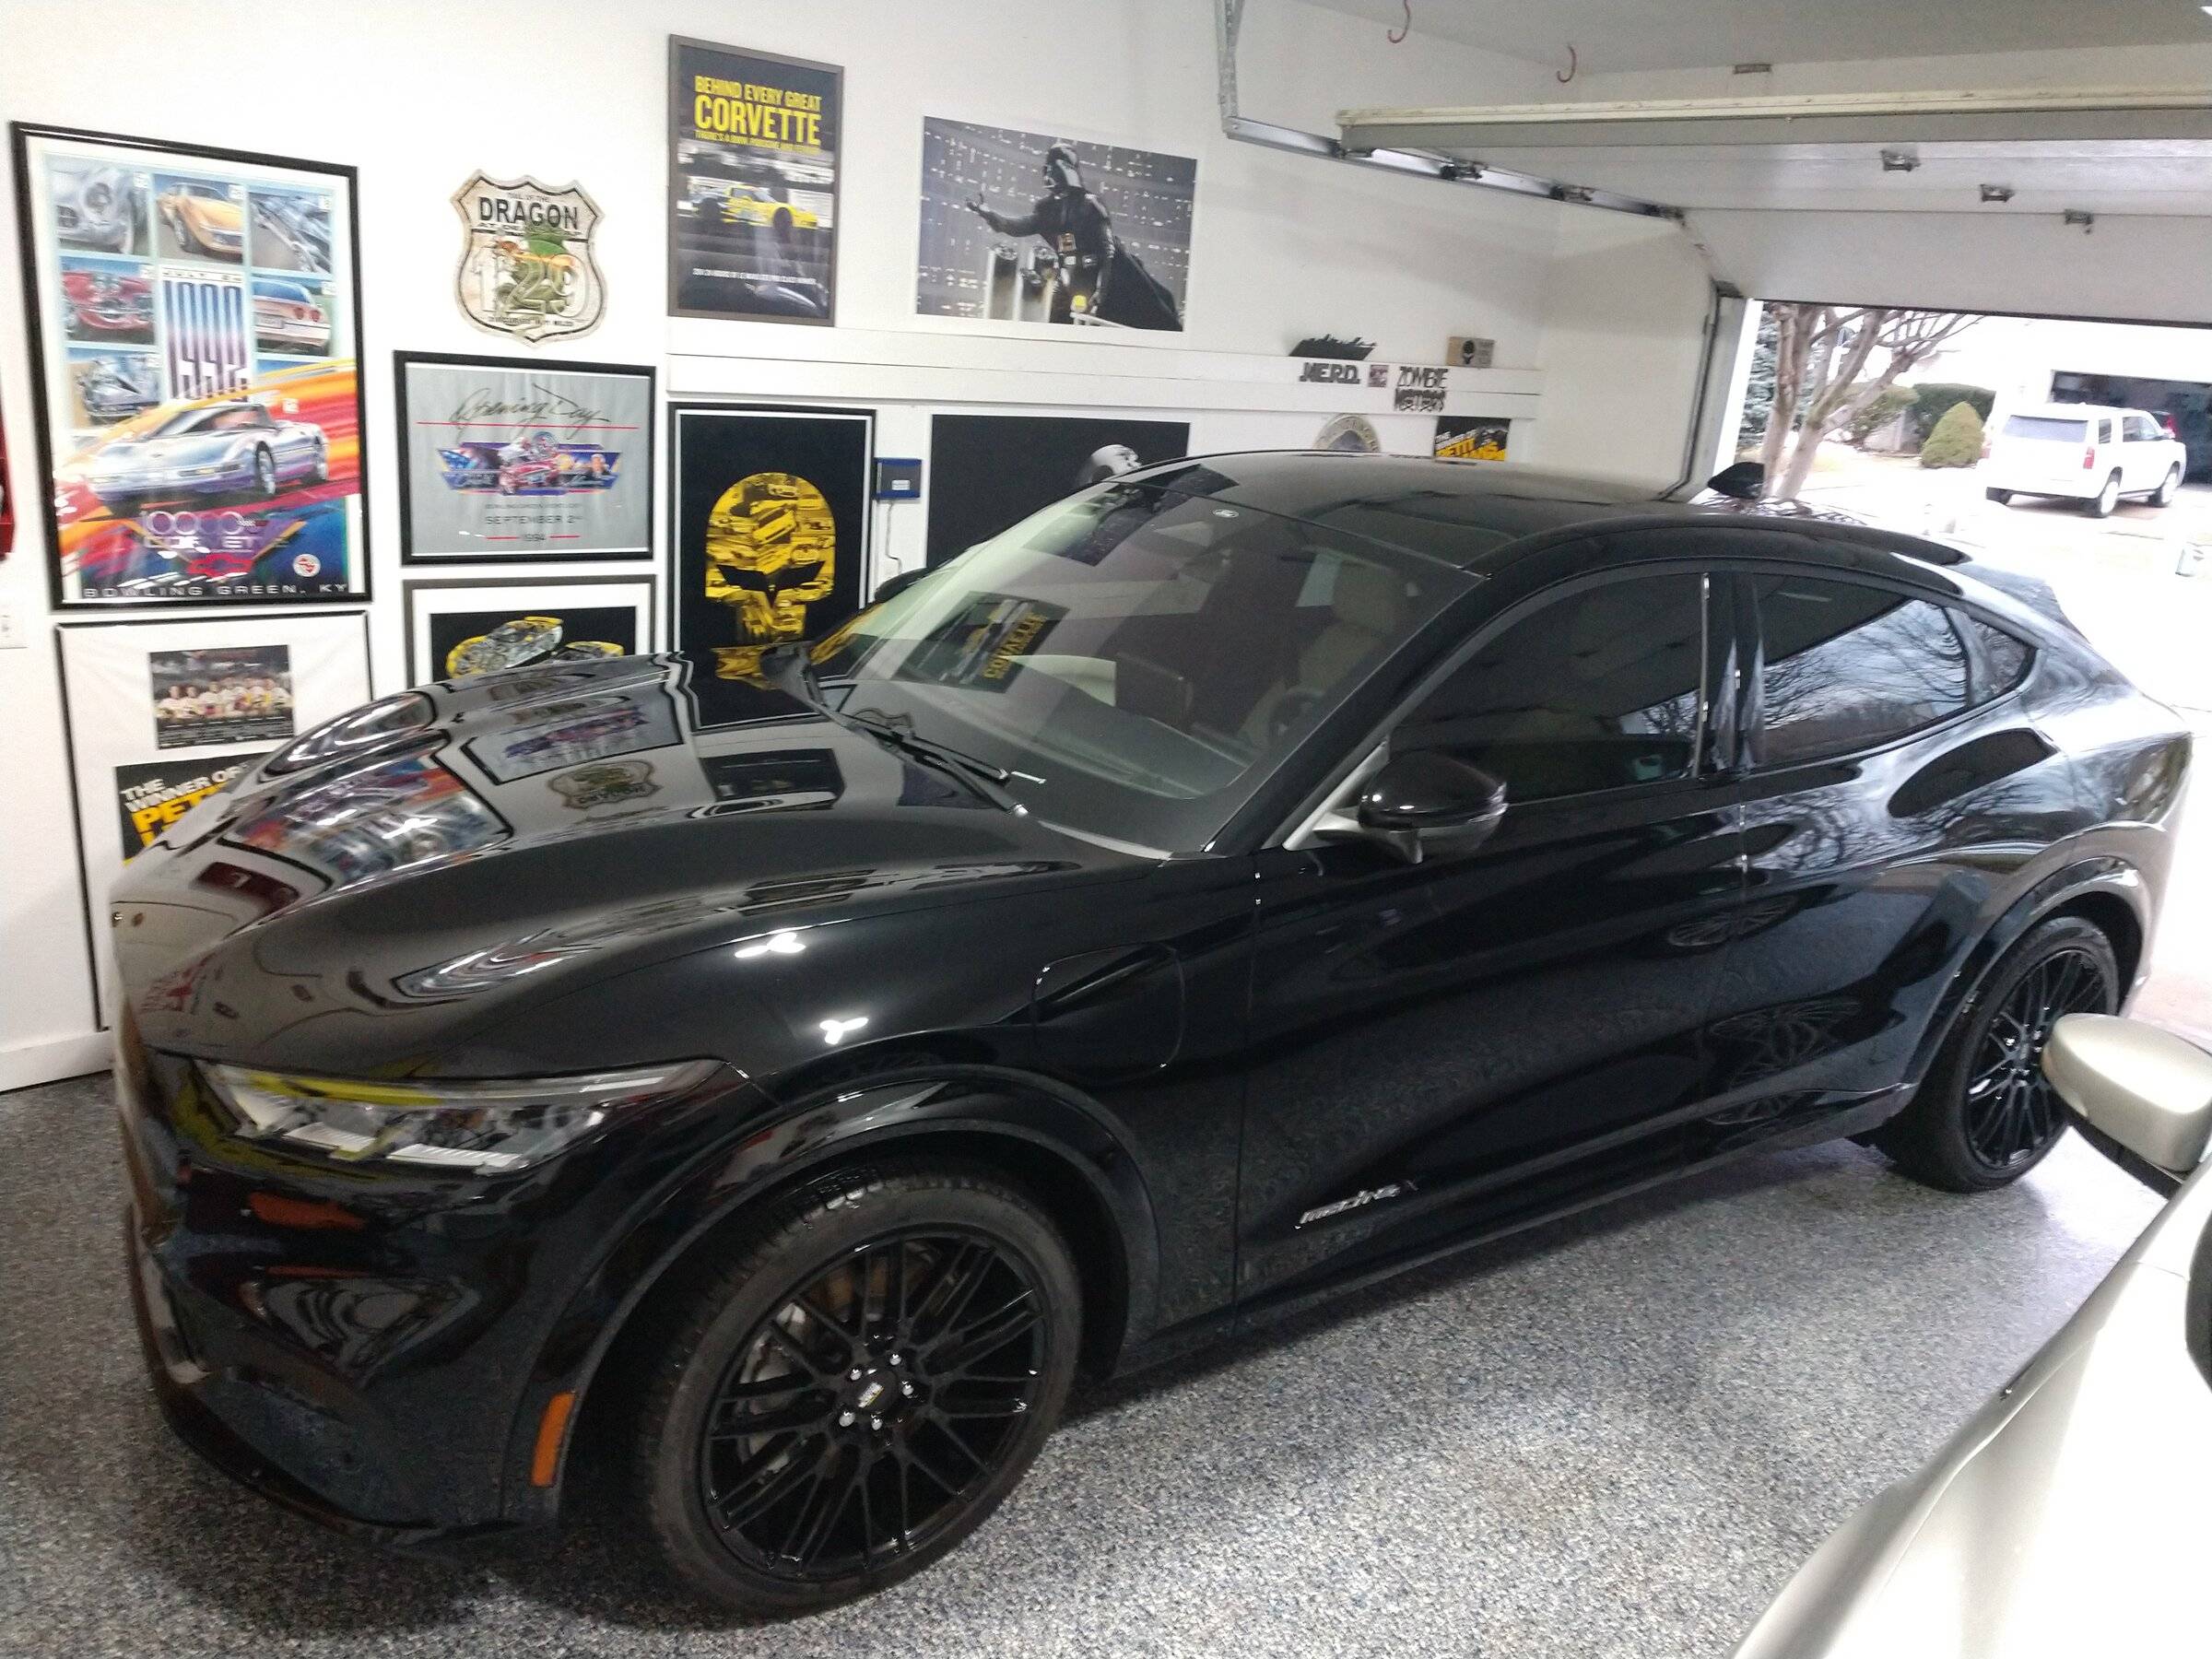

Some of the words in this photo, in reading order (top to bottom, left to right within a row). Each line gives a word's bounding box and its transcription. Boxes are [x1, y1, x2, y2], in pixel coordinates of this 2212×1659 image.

[695, 76, 743, 99] BEHIND
[744, 84, 783, 106] EVERY
[784, 90, 822, 112] GREAT
[694, 95, 822, 147] CORVETTE
[478, 197, 578, 229] DRAGON
[485, 515, 562, 524] SEPTEMBER
[84, 585, 203, 598] BOWLING
[216, 584, 306, 595] GREEN,
[319, 582, 348, 594] KY
[121, 779, 166, 800] THE
[124, 776, 213, 813] WINNER
